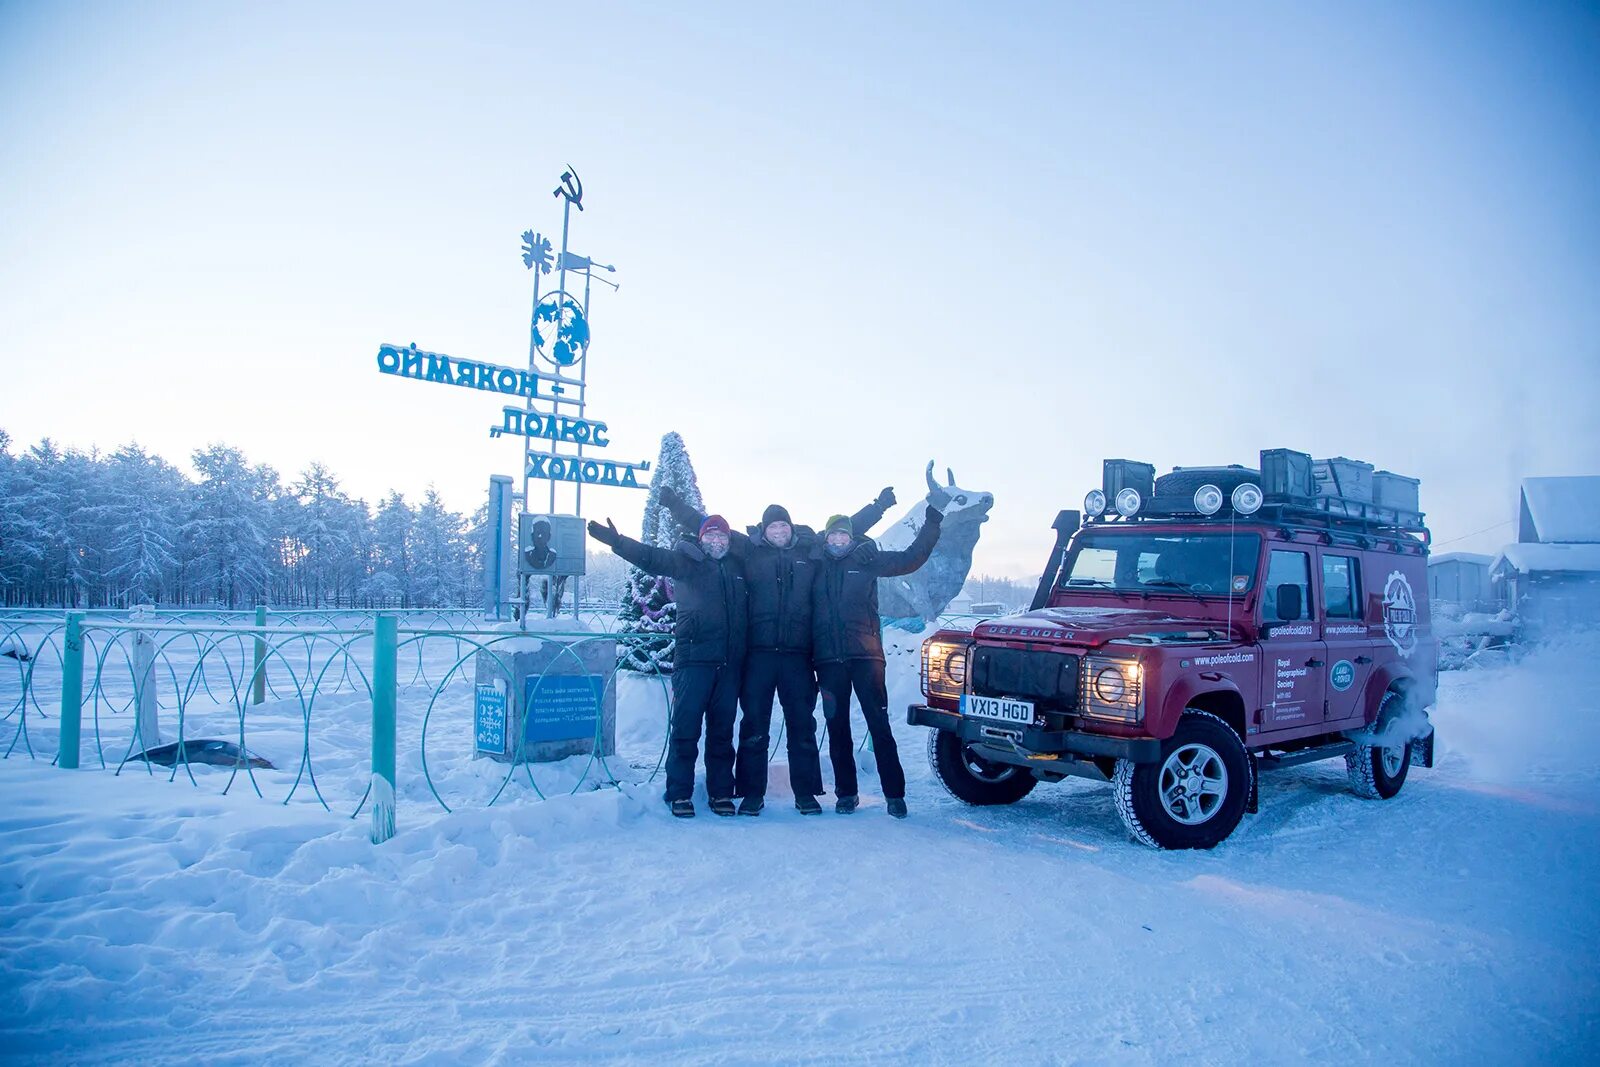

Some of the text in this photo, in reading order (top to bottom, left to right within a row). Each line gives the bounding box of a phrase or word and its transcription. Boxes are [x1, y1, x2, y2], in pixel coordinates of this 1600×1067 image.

[377, 342, 539, 398] ОЙМЯКОН
[988, 626, 1076, 640] DEFENDER
[1270, 625, 1312, 637] @poleofcold2013
[1194, 653, 1254, 667] www.poleofcold.com
[1277, 659, 1290, 668] Royal
[1277, 668, 1307, 678] Geographical
[1276, 680, 1295, 689] Society
[971, 698, 1029, 721] VX13 HGD
